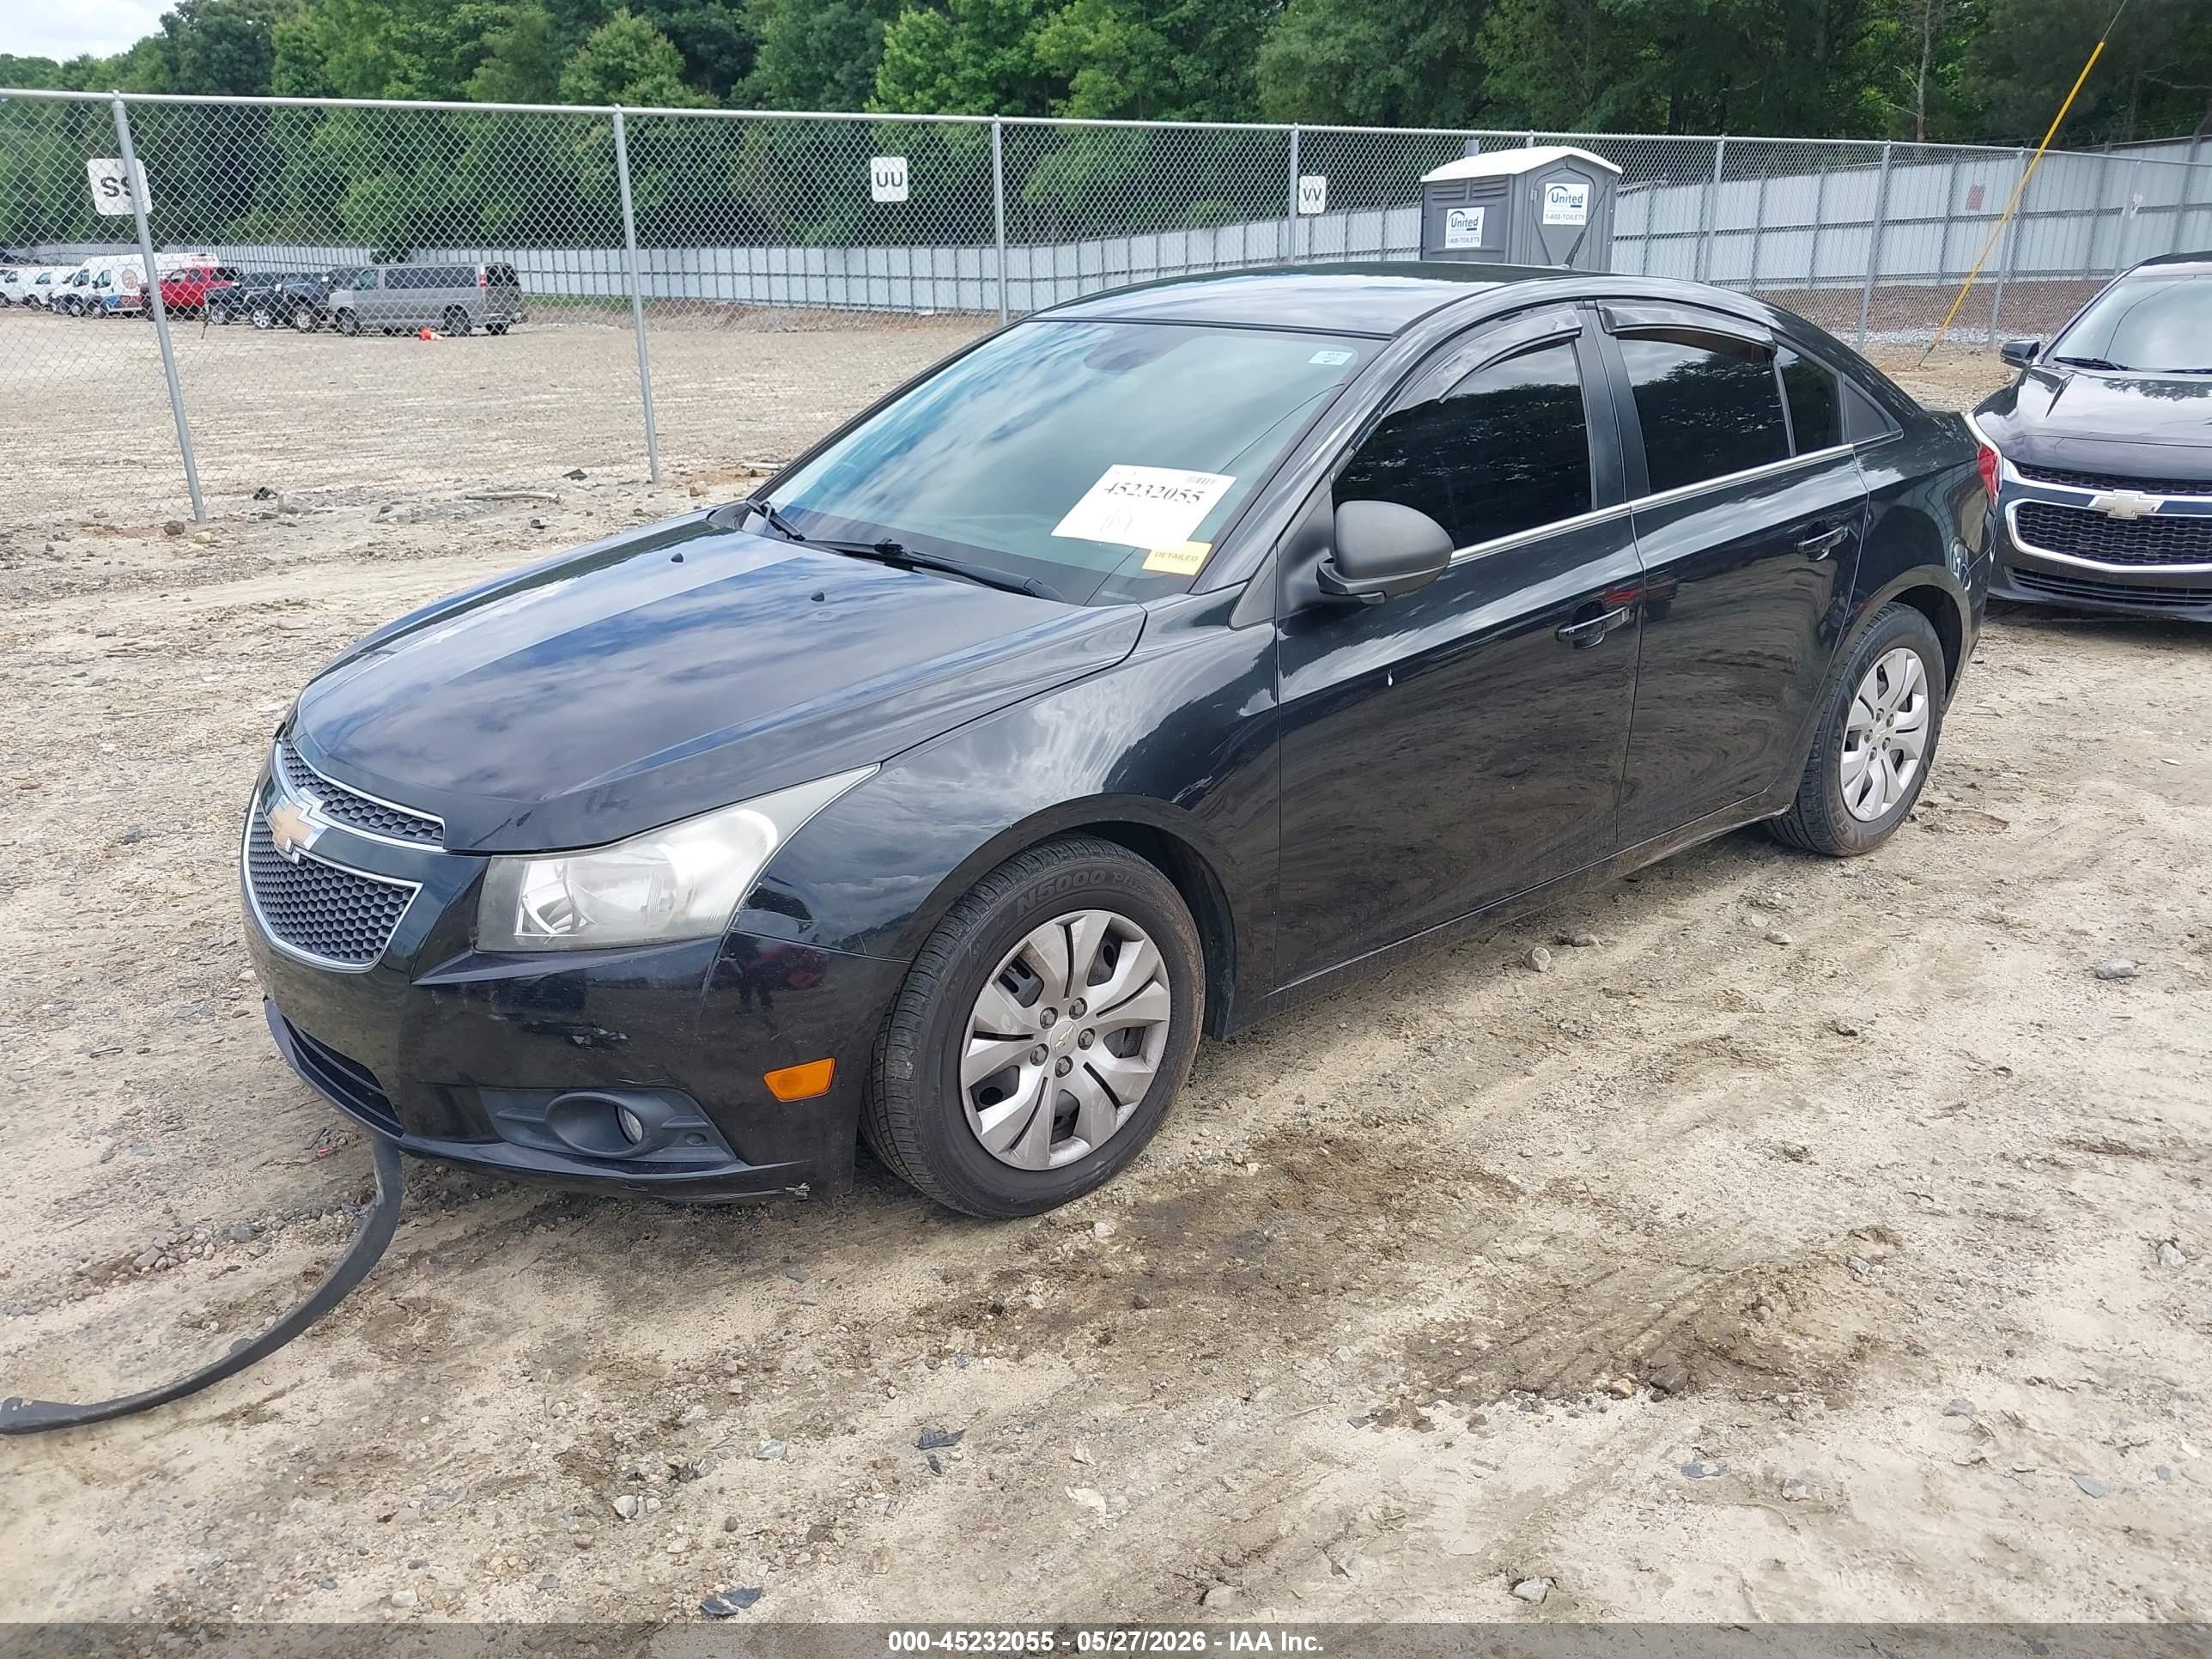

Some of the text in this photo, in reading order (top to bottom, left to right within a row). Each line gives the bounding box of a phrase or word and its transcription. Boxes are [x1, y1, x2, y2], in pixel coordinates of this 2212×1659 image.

[876, 171, 903, 187] UU
[1551, 191, 1583, 204] United
[1451, 216, 1480, 228] United
[1104, 482, 1206, 504] 45232055
[1154, 551, 1199, 562] DETAILED
[1017, 869, 1106, 917] N5000
